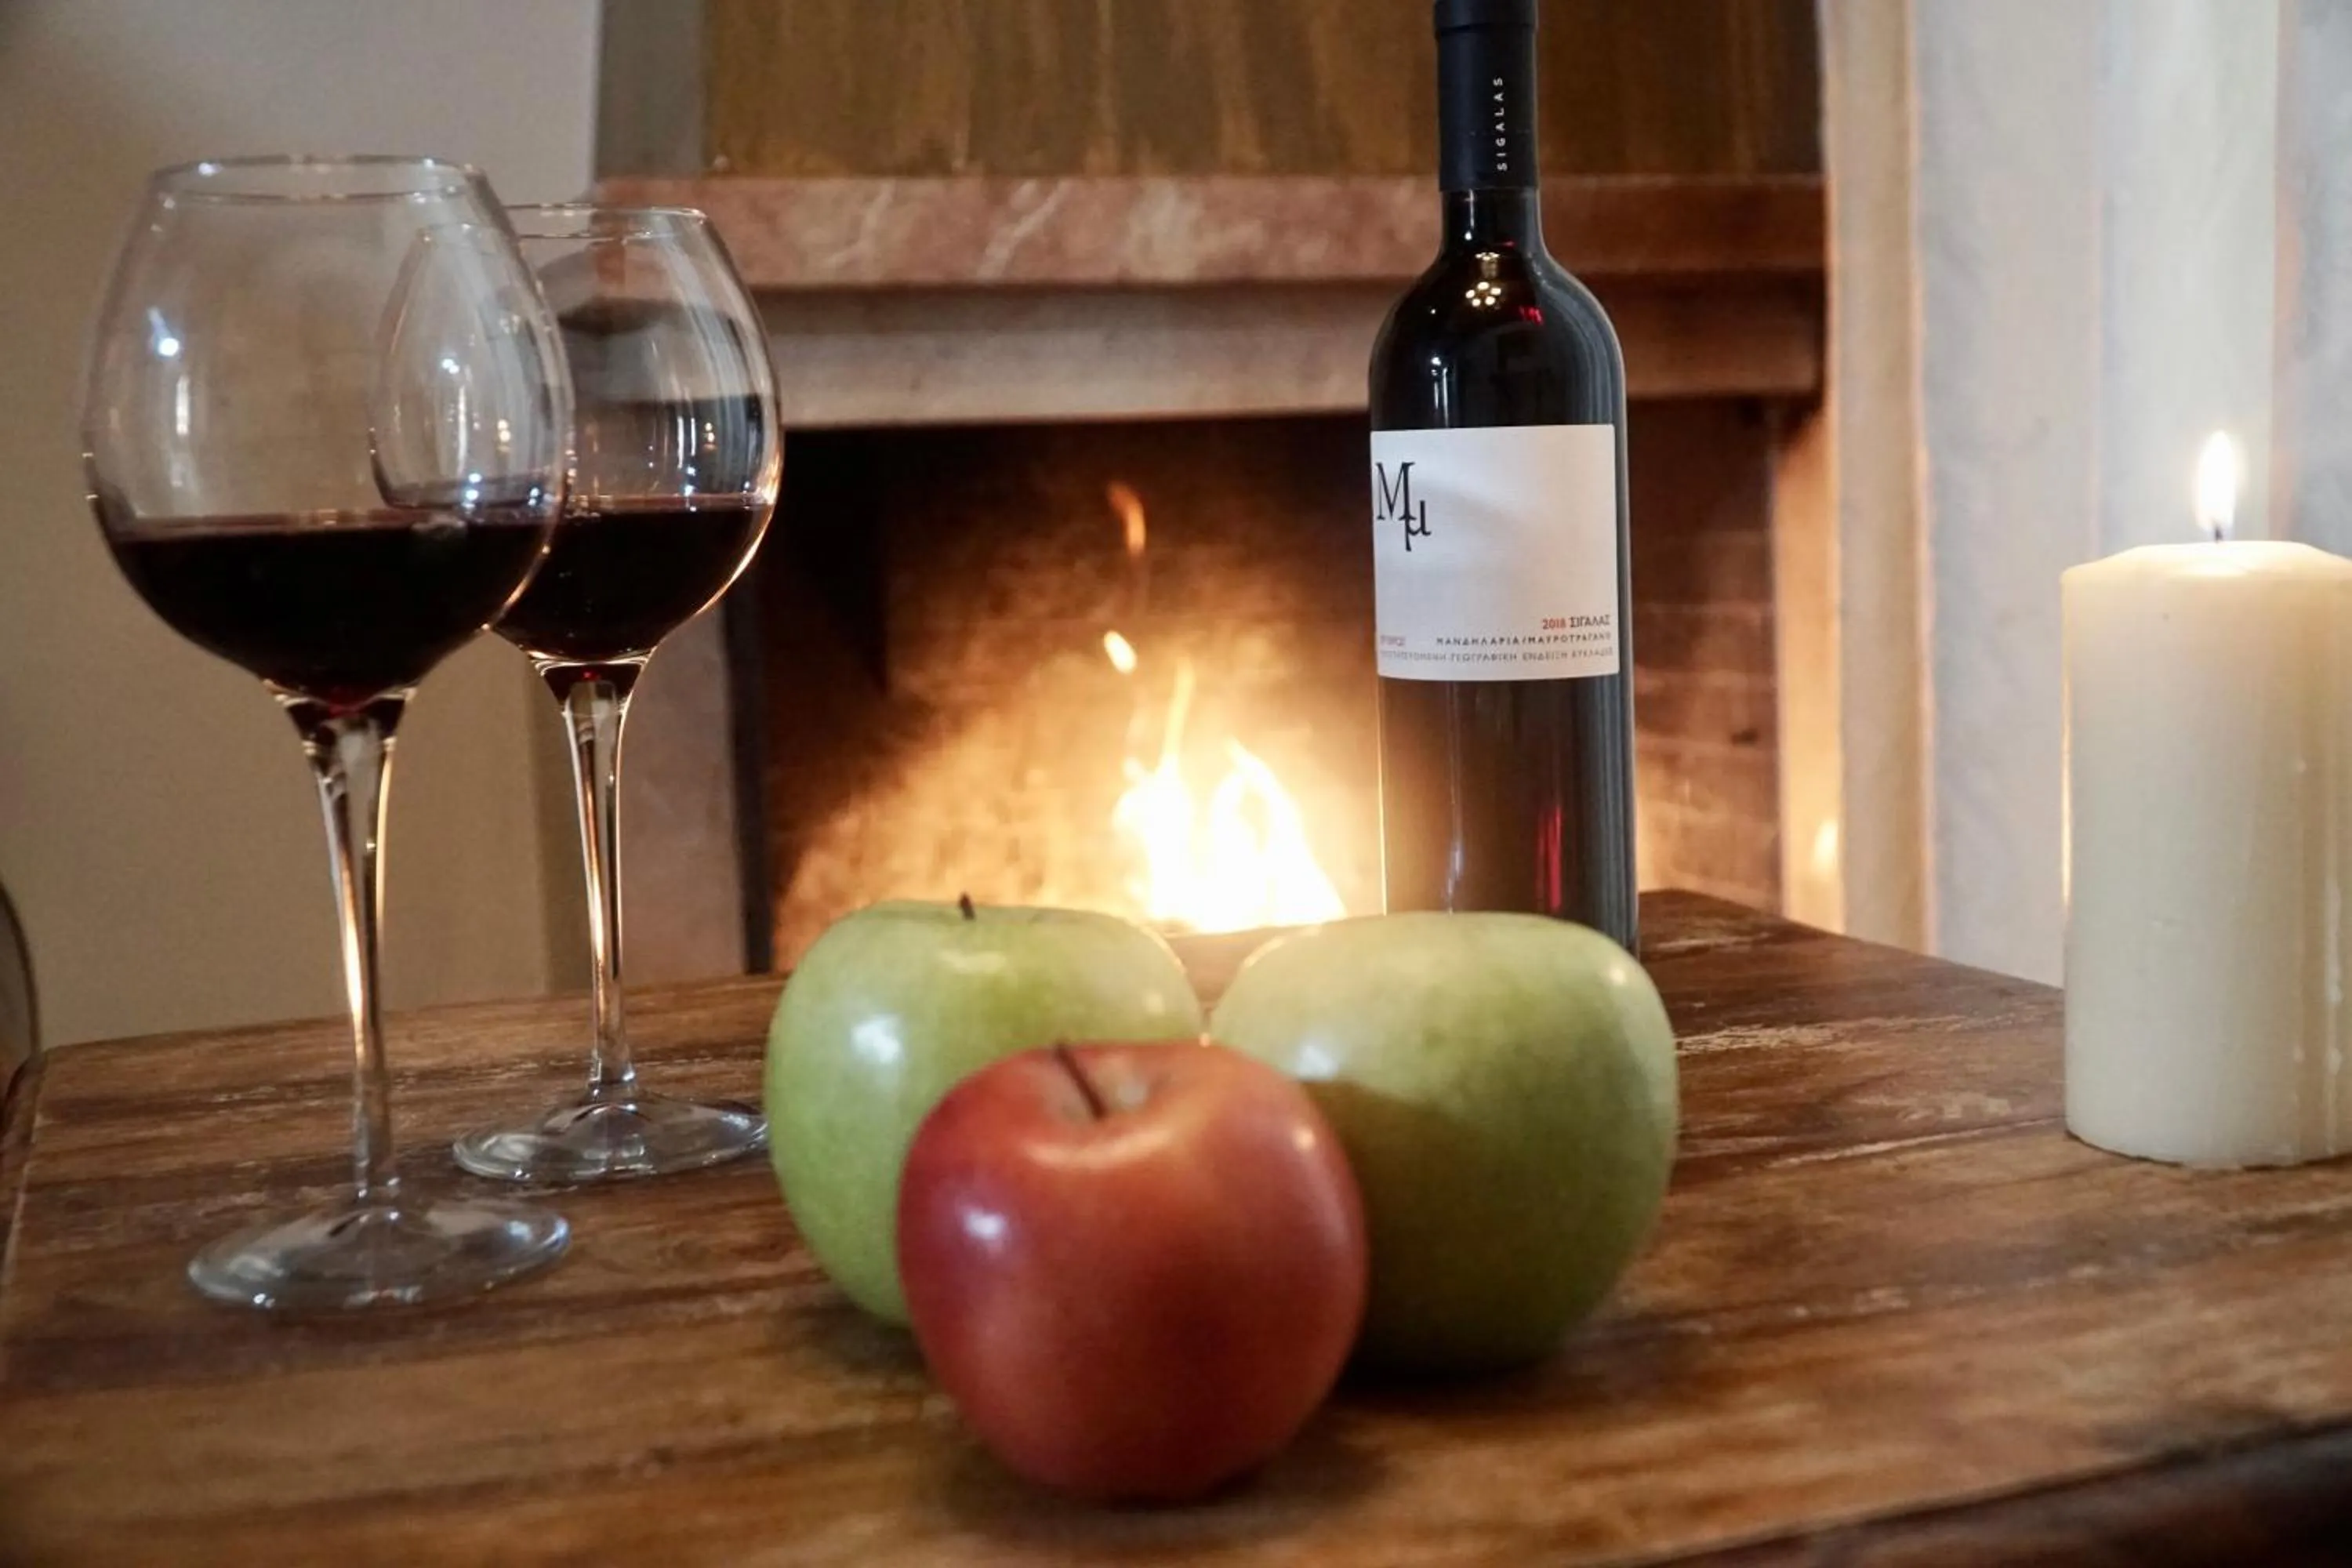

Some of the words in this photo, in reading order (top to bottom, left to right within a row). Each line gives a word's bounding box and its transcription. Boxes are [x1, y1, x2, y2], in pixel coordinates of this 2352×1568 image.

[1493, 77, 1508, 172] SIGALAS
[1542, 617, 1566, 630] 2018
[1569, 614, 1611, 628] ΣΙΓΑΛΑΣ
